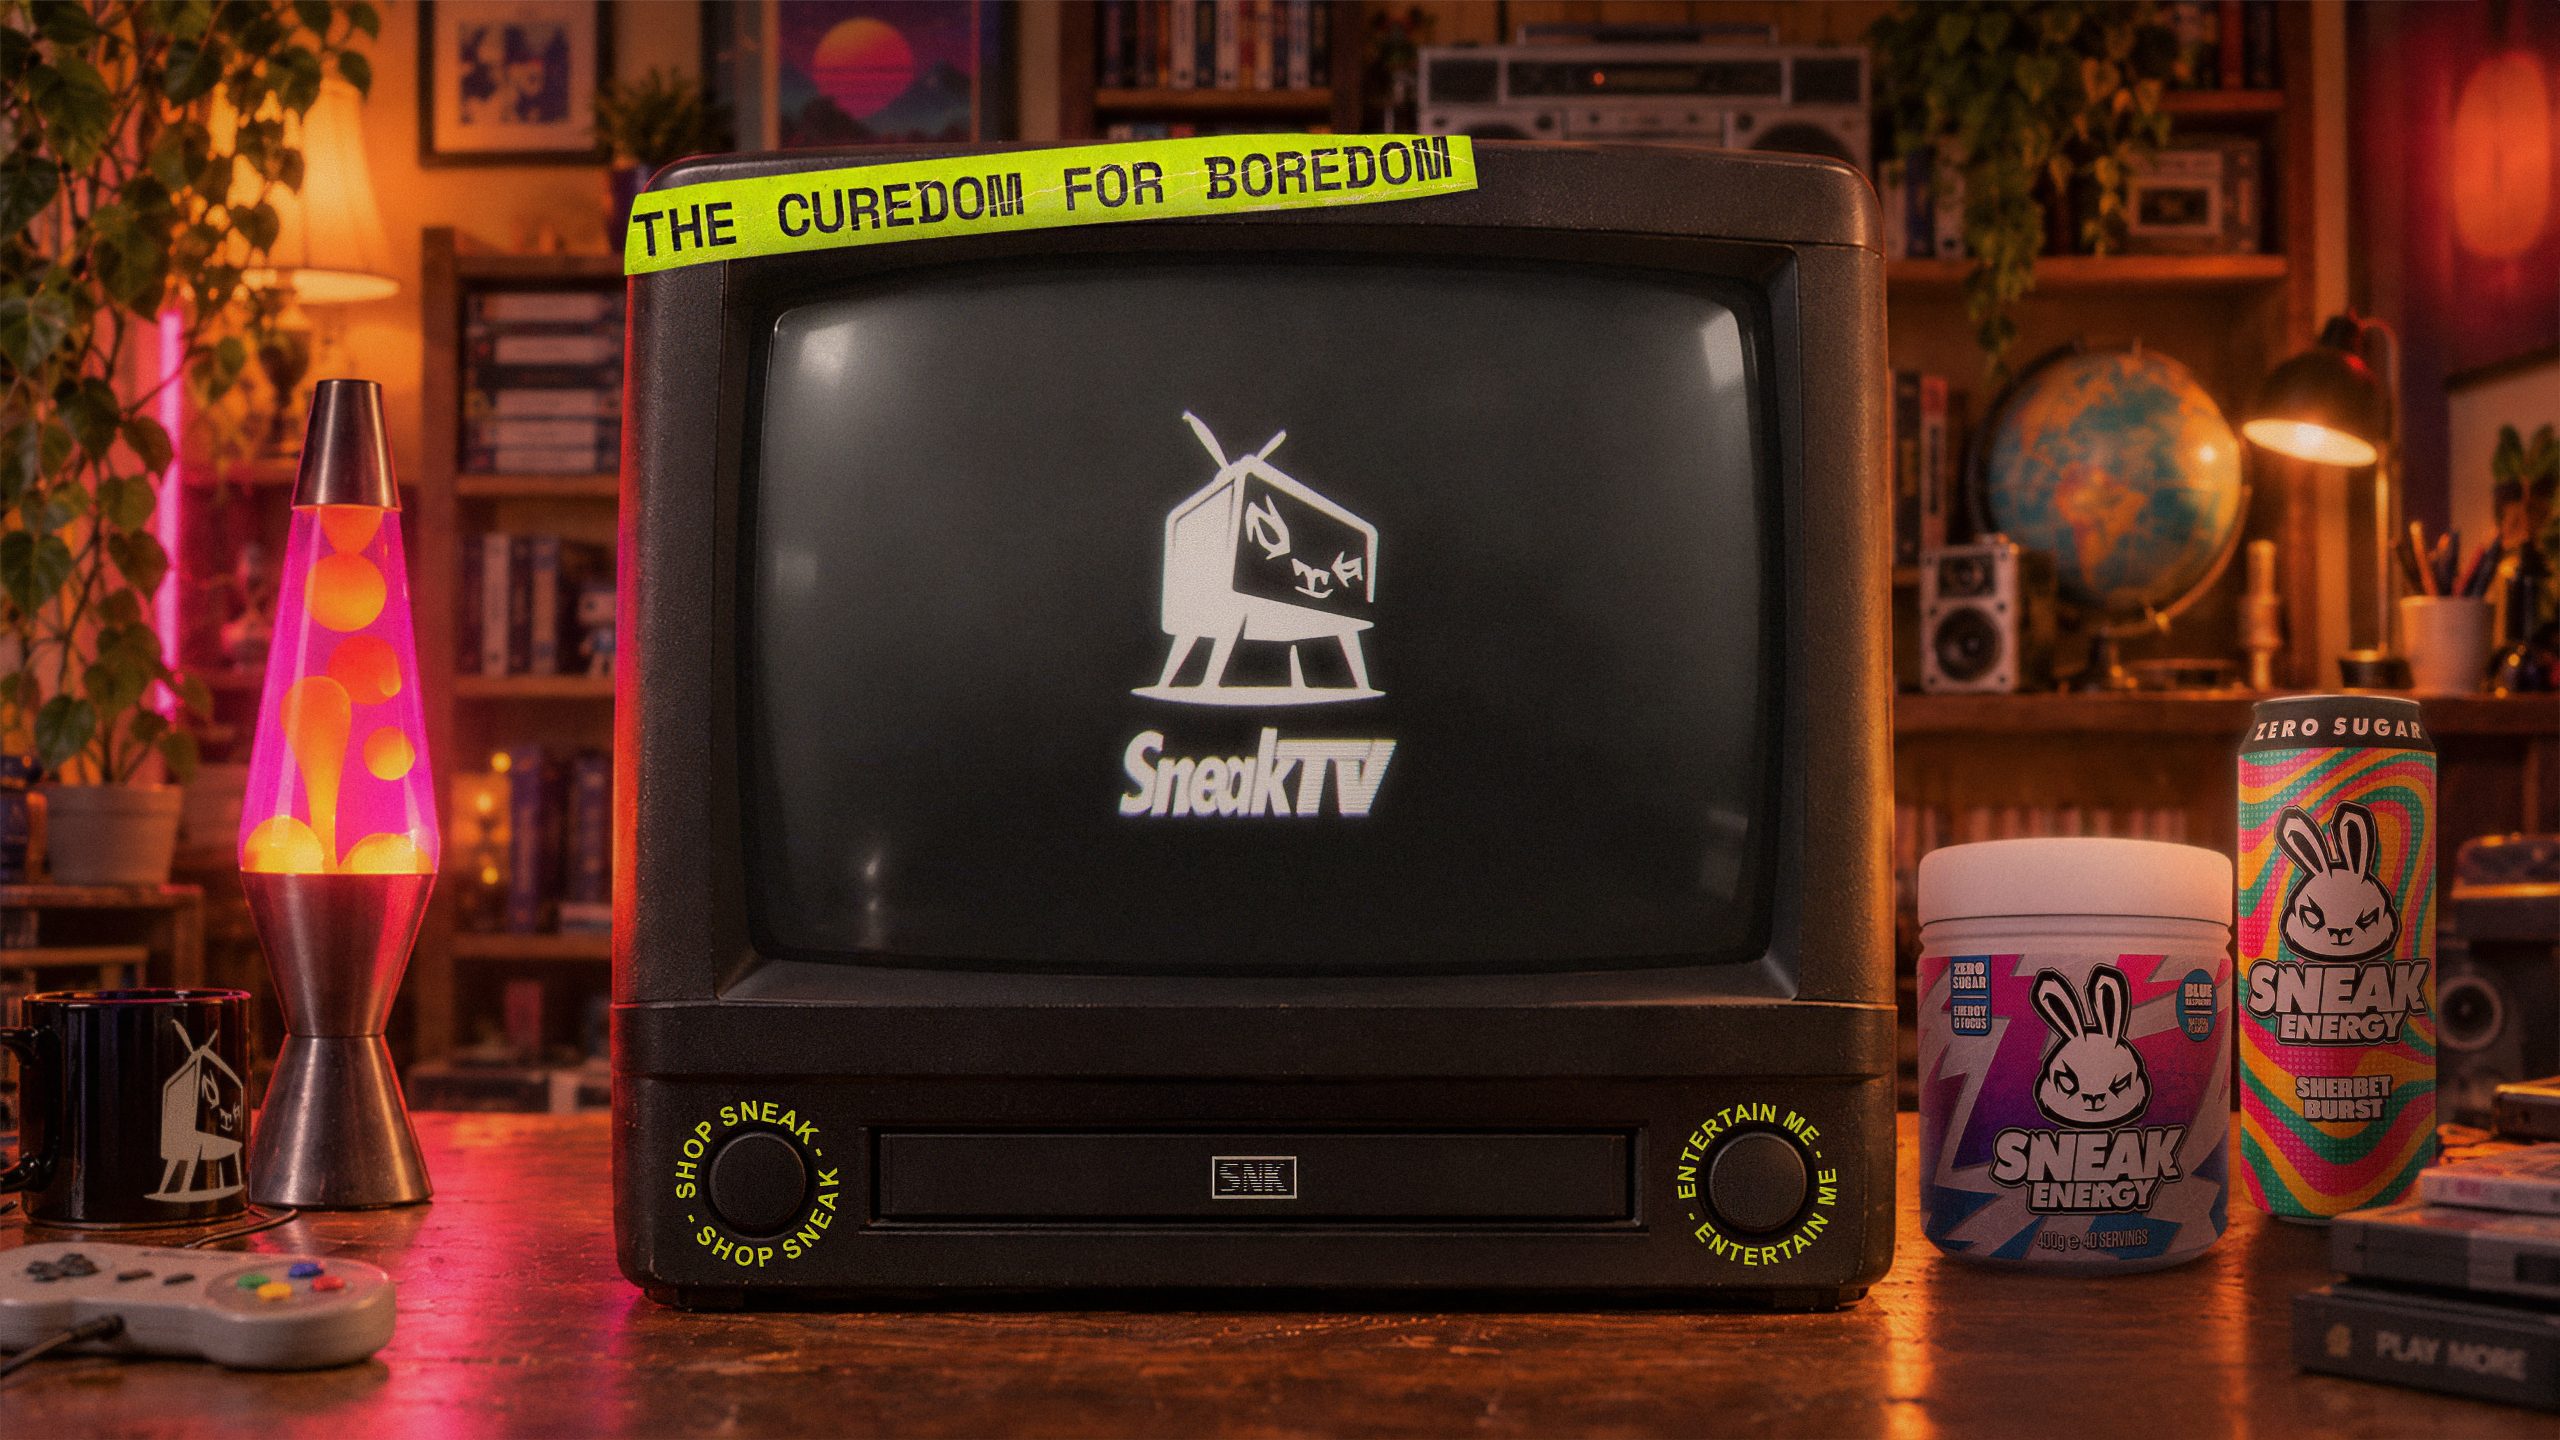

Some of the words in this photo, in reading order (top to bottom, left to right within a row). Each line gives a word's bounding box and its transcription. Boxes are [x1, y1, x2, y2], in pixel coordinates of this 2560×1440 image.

[632, 202, 737, 257] THE
[777, 172, 1025, 238] CUREDOM
[1063, 161, 1164, 211] FOR
[1203, 136, 1453, 200] BOREDOM
[2253, 718, 2319, 742] ZERO
[2332, 717, 2423, 740] SUGAR
[1118, 727, 1398, 817] SneakTV
[1952, 976, 1987, 989] SUGAR
[1953, 962, 1985, 975] ZERO
[2184, 983, 2213, 998] BLUE
[2247, 963, 2429, 1014] SNEAK
[1953, 1005, 1988, 1016] ENERGY
[1960, 1017, 1987, 1029] FOCUS
[2280, 1013, 2404, 1040] ENERGY
[2296, 1076, 2392, 1098] SHERBET
[2304, 1099, 2384, 1120] BURST
[675, 1120, 713, 1199] SHOP
[719, 1100, 820, 1146] SNEAK
[1677, 1102, 1777, 1200] ENTERTAIN
[1782, 1110, 1821, 1147] ME
[1993, 1129, 2184, 1182] SNEAK
[1219, 1163, 1288, 1192] SNK
[2031, 1179, 2156, 1208] ENERGY
[696, 1225, 774, 1268] SHOP
[782, 1167, 840, 1260] SNEAK
[1694, 1212, 1829, 1267] ENTERTAIN
[1817, 1168, 1838, 1206] ME
[2036, 1231, 2067, 1251] 400g
[2082, 1231, 2098, 1249] 40
[2099, 1229, 2149, 1248] SERVINGS
[2374, 1330, 2440, 1365] PLAY
